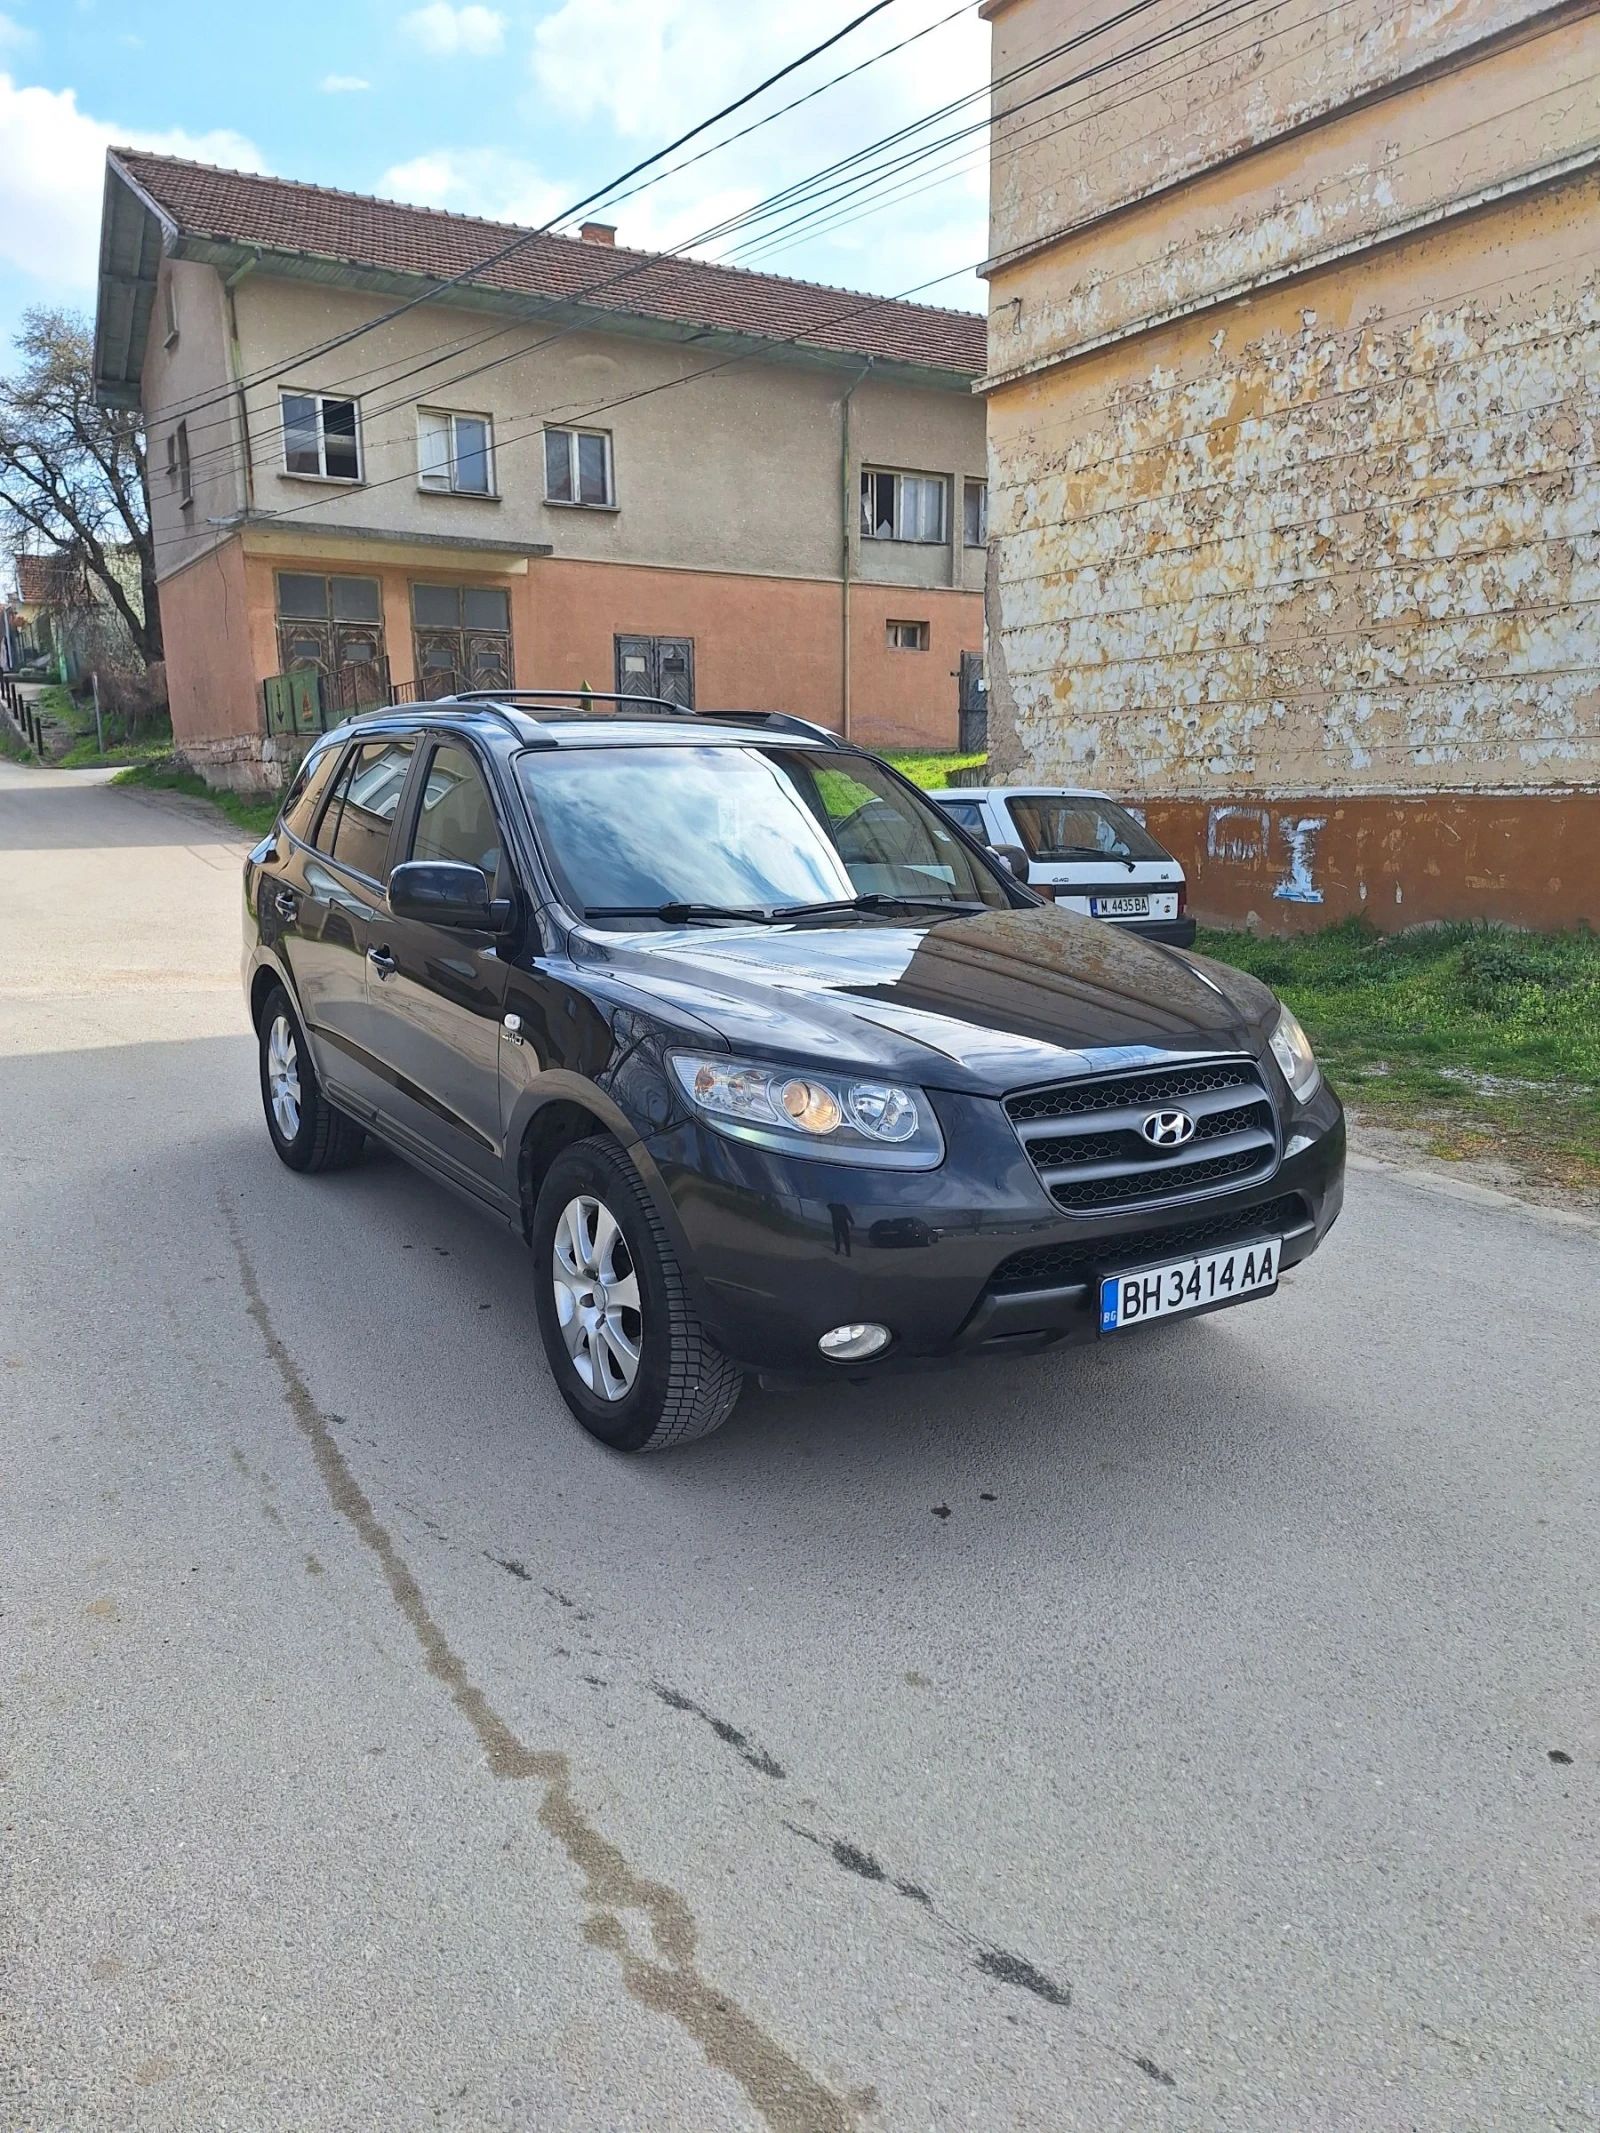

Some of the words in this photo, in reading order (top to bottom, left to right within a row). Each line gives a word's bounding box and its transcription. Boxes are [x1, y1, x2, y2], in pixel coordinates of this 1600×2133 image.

[1123, 1275, 1162, 1320] BH
[1167, 1257, 1234, 1306] 3414
[1240, 1247, 1273, 1288] AA
[1103, 1311, 1117, 1323] BG
